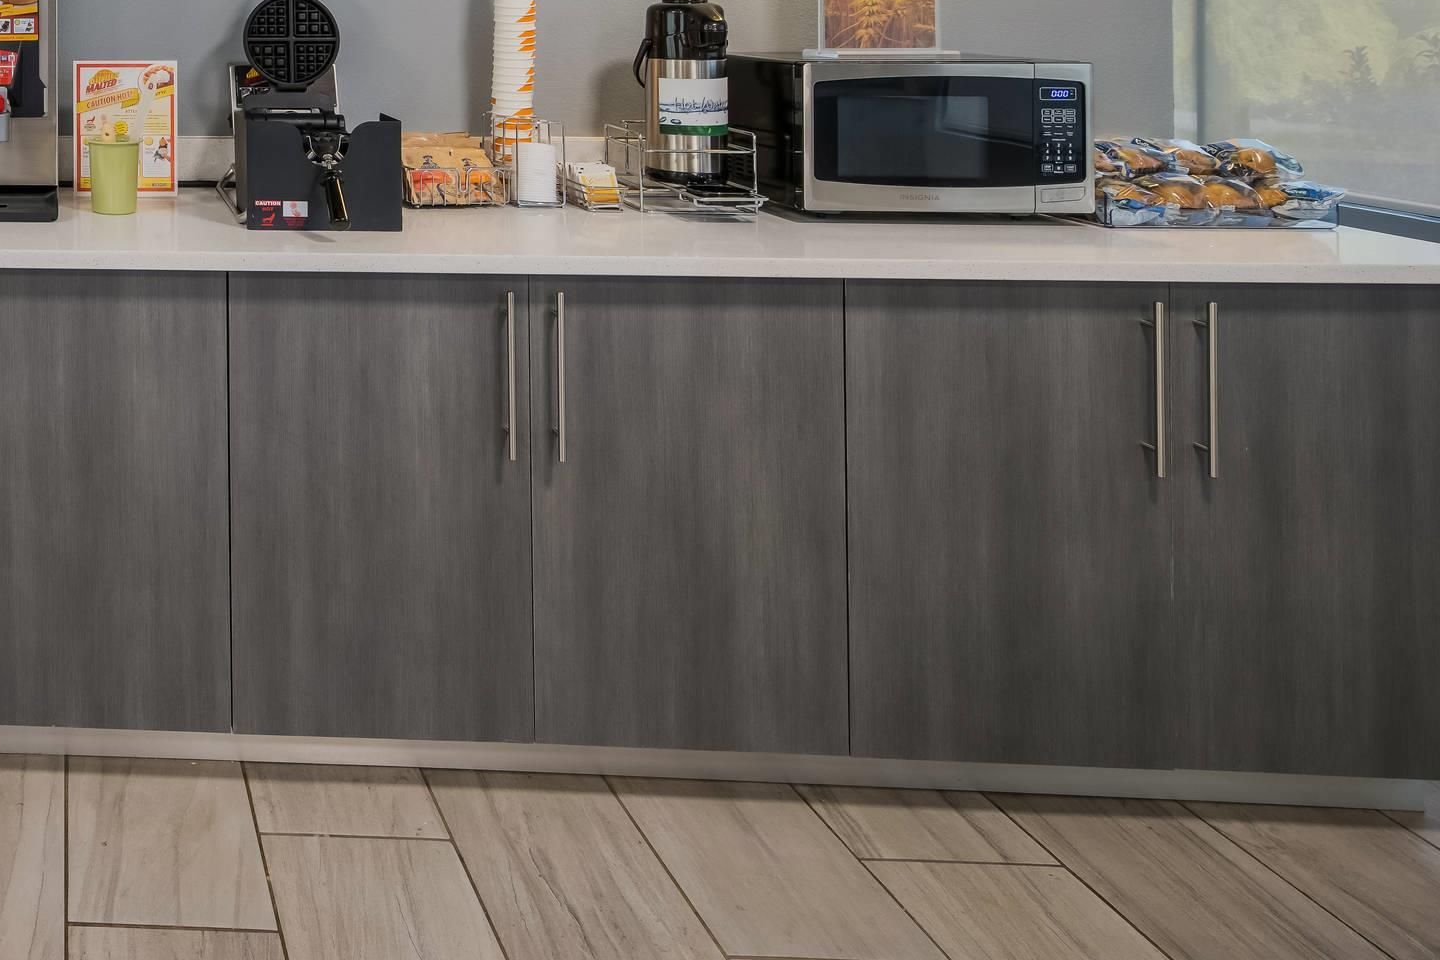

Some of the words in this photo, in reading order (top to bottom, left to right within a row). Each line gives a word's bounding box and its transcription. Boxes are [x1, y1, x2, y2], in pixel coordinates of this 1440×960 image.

[86, 78, 118, 94] MALTED
[86, 96, 116, 109] CAUTION
[117, 90, 133, 102] HOT!
[675, 97, 698, 111] Hot
